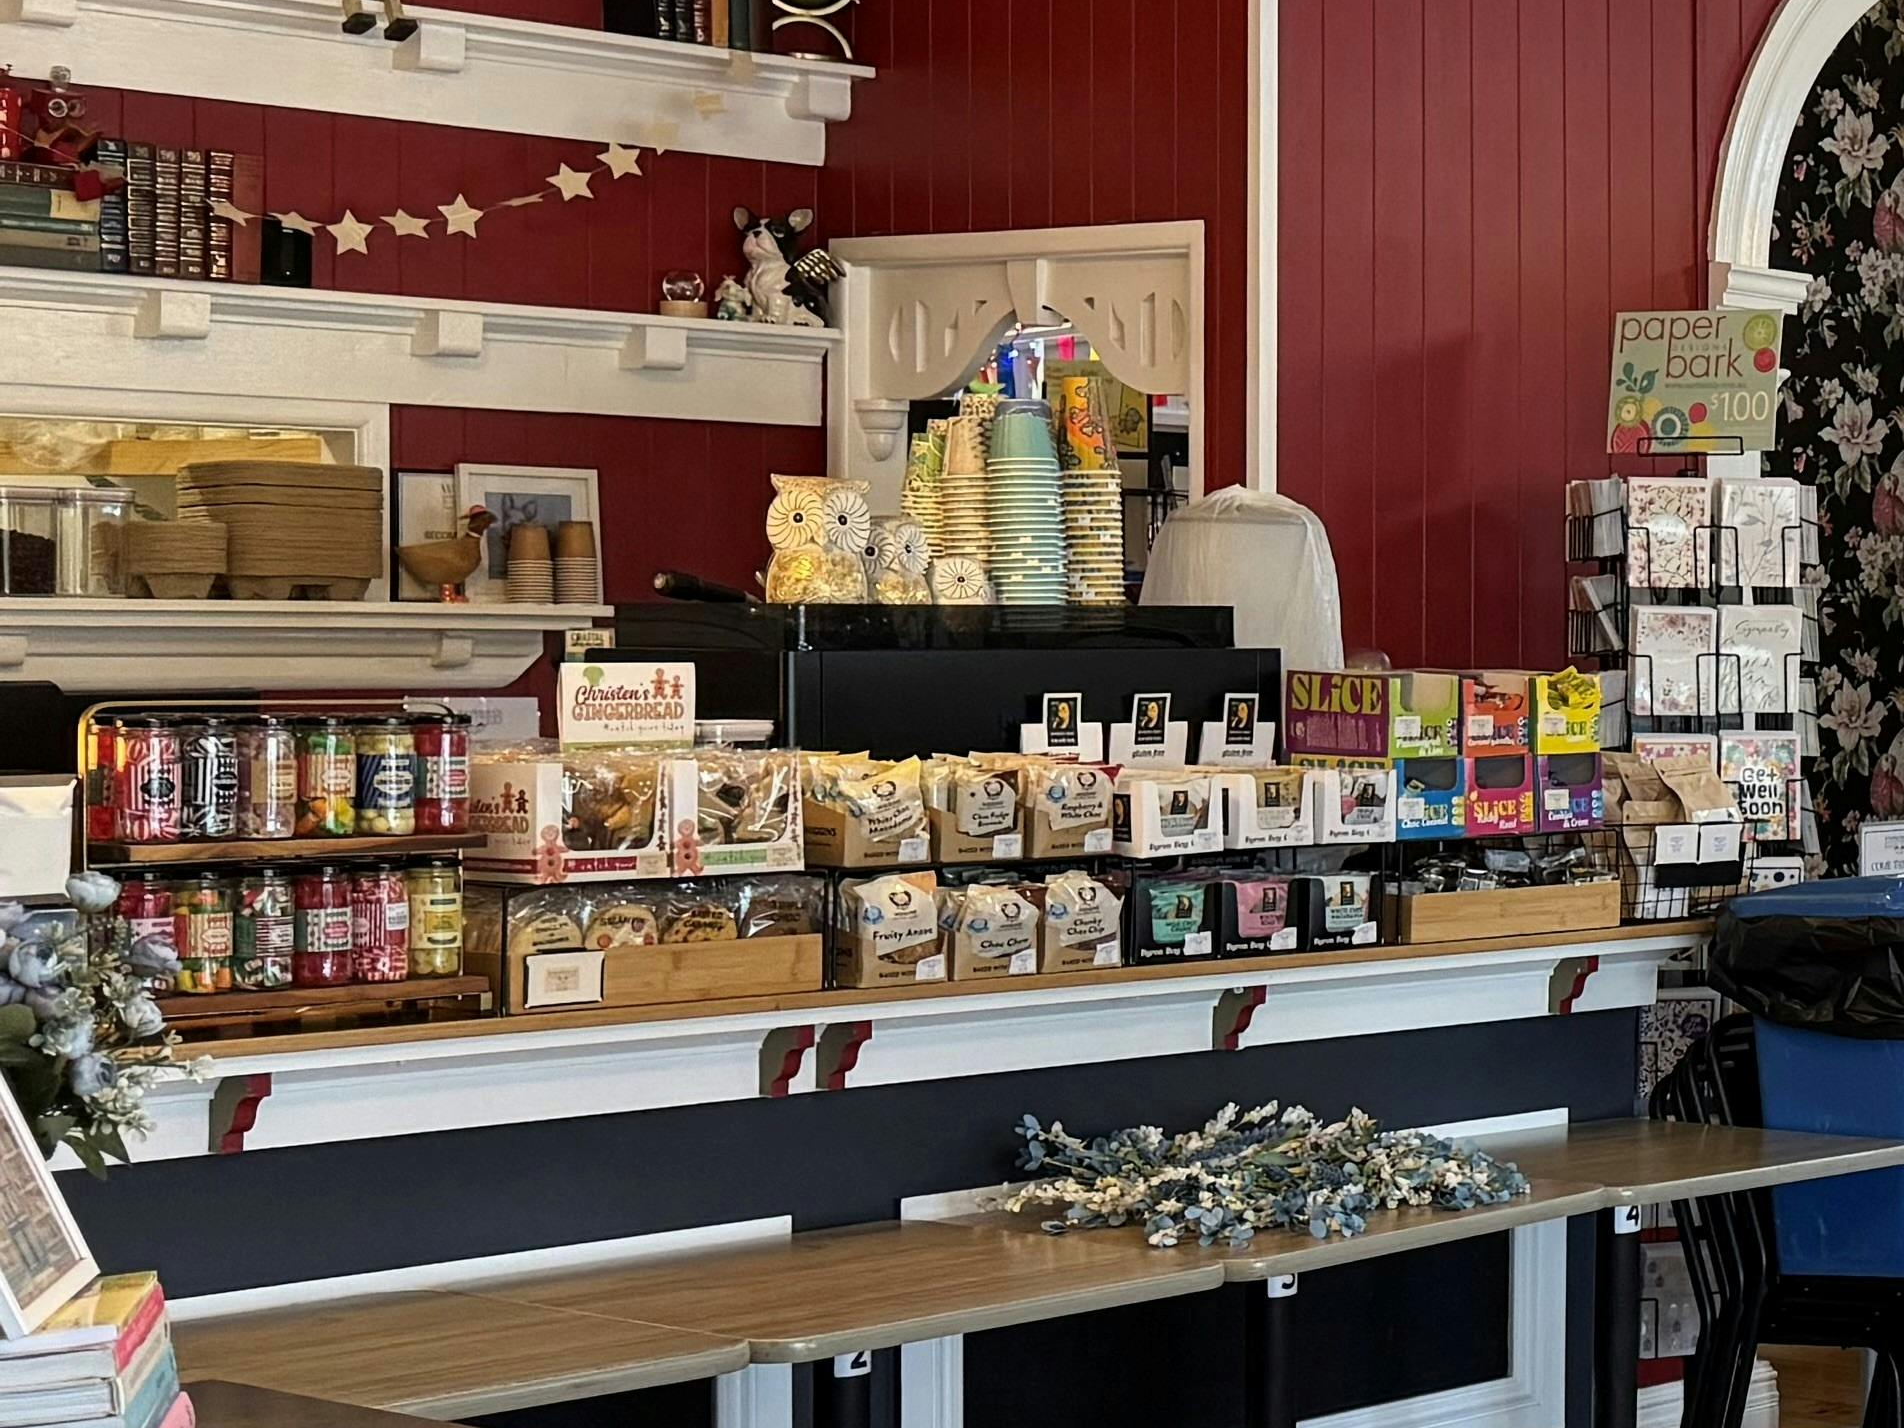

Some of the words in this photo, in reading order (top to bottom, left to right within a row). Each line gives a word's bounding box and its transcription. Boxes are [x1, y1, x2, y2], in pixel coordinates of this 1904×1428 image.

[1619, 315, 1727, 354] paper
[1665, 337, 1743, 379] bark
[1711, 391, 1769, 421] $1.00
[1736, 620, 1791, 639] Sympathy
[575, 683, 650, 704] Christen's
[572, 702, 685, 721] GINGERBREAD
[1742, 767, 1778, 783] Get
[1740, 783, 1778, 799] Well
[1738, 800, 1783, 816] Soon
[872, 929, 903, 941] Fruity
